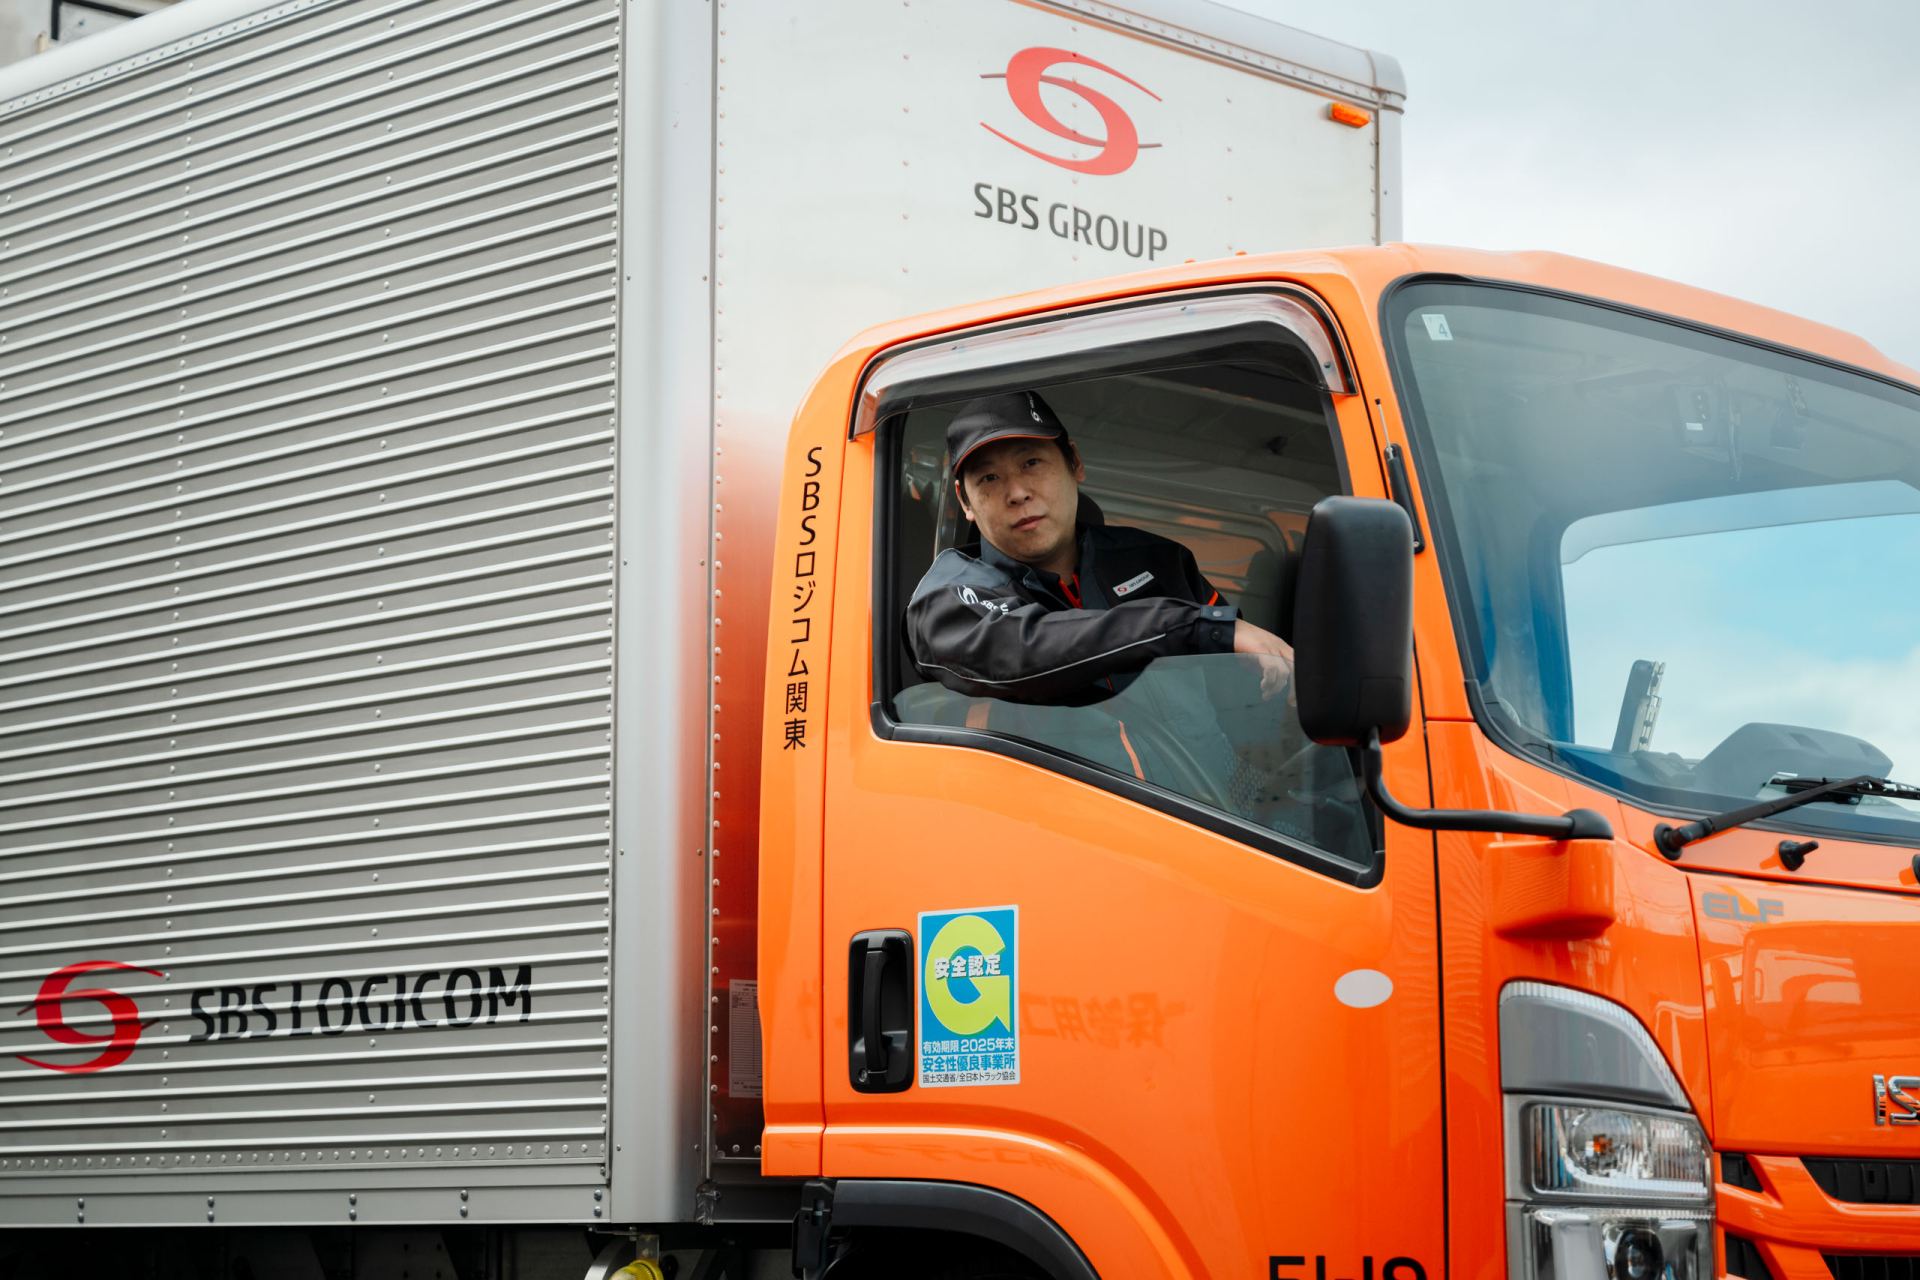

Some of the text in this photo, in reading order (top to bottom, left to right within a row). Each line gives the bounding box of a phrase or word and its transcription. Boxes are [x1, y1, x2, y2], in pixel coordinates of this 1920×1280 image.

[974, 182, 1167, 261] SBS GROUP
[783, 446, 822, 750] SBSロジコム関東
[1702, 892, 1784, 924] ELF
[934, 954, 1001, 980] 安全認定
[188, 964, 532, 1042] SBS LOGICOM
[922, 1053, 1016, 1073] 安全性優良事業所
